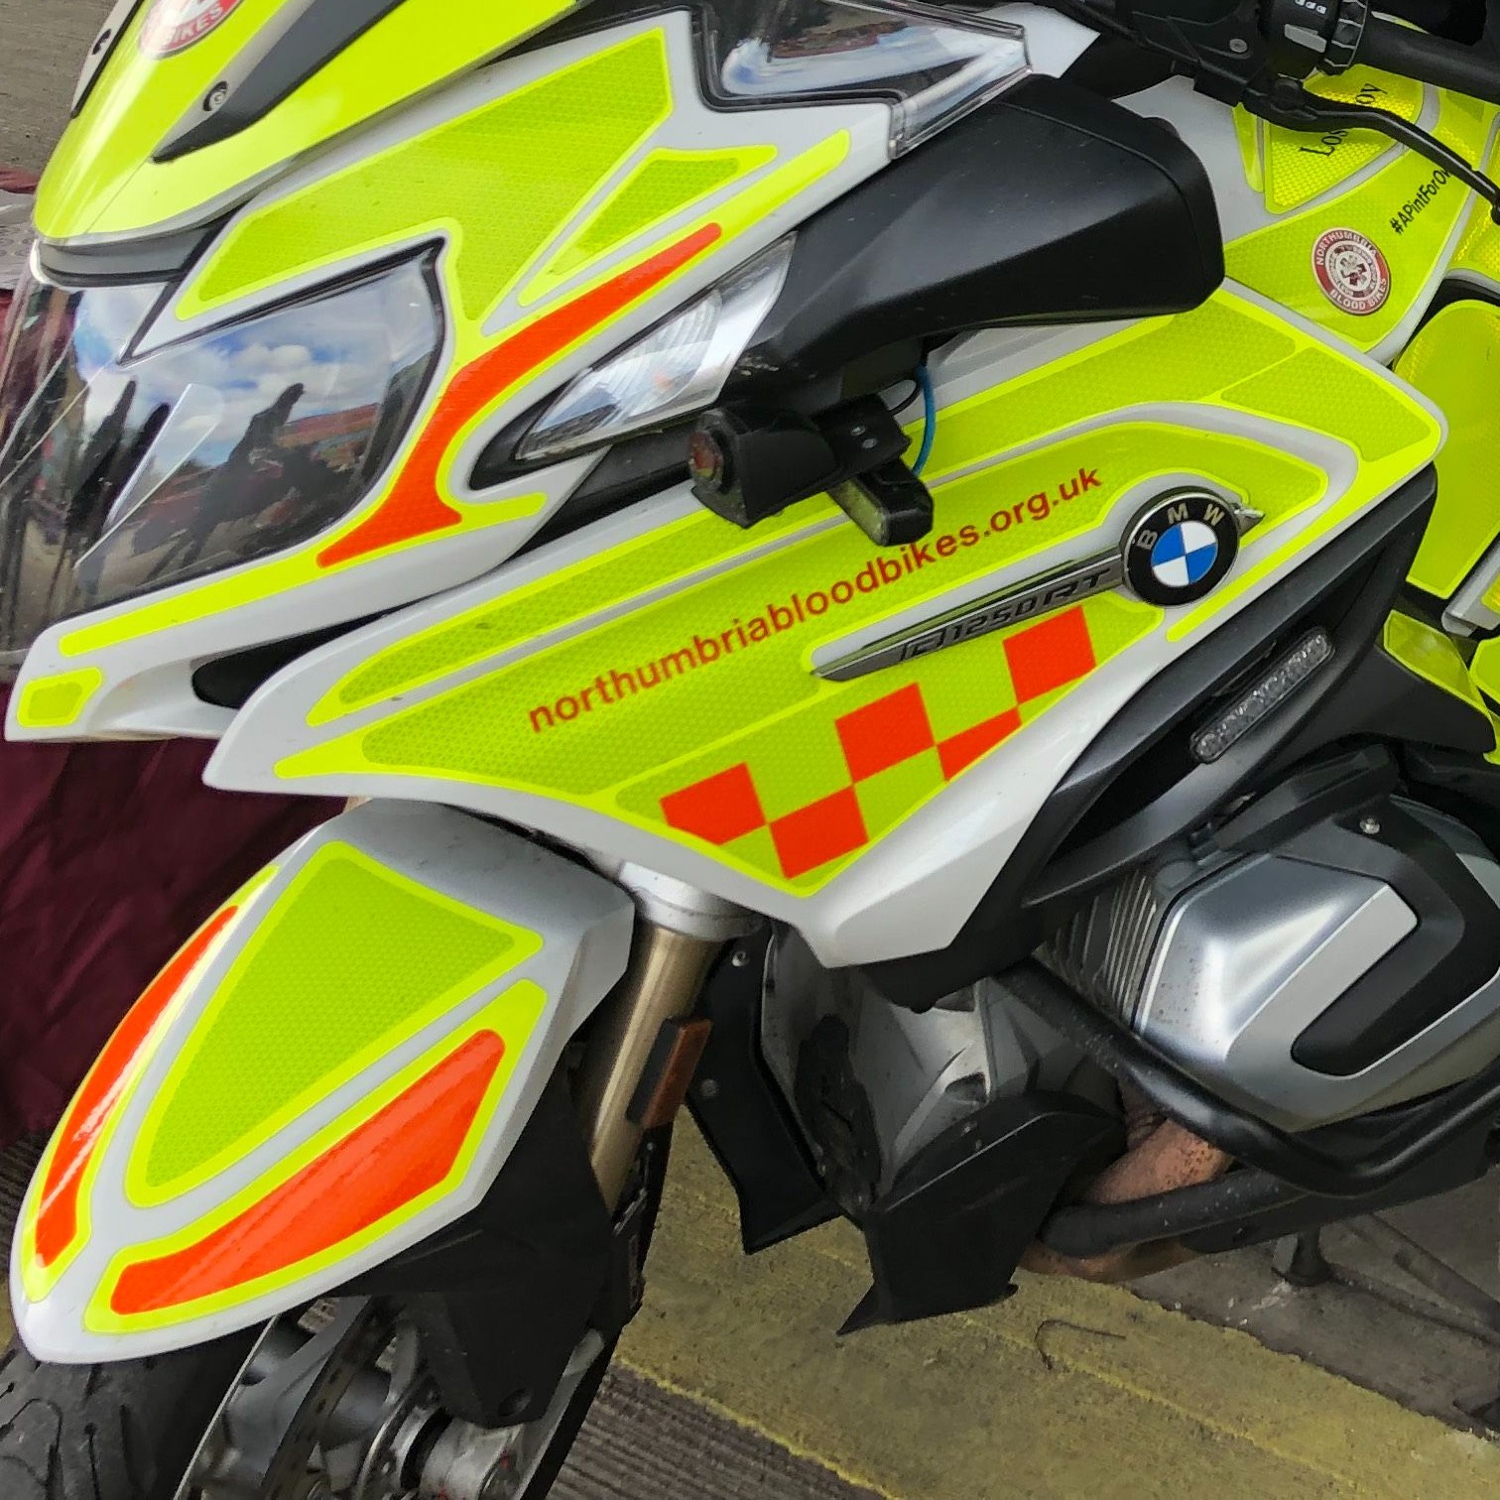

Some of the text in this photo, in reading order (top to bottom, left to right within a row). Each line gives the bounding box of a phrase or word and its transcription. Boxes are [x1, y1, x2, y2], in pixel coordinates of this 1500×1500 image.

[172, 3, 224, 42] IKES
[1355, 83, 1388, 104] oy
[1330, 288, 1366, 310] BLOOD
[1137, 501, 1225, 551] BMW
[528, 465, 1102, 733] northumbriabloodbikes.org.uk
[951, 596, 1040, 641] 1250
[1044, 567, 1112, 607] RT
